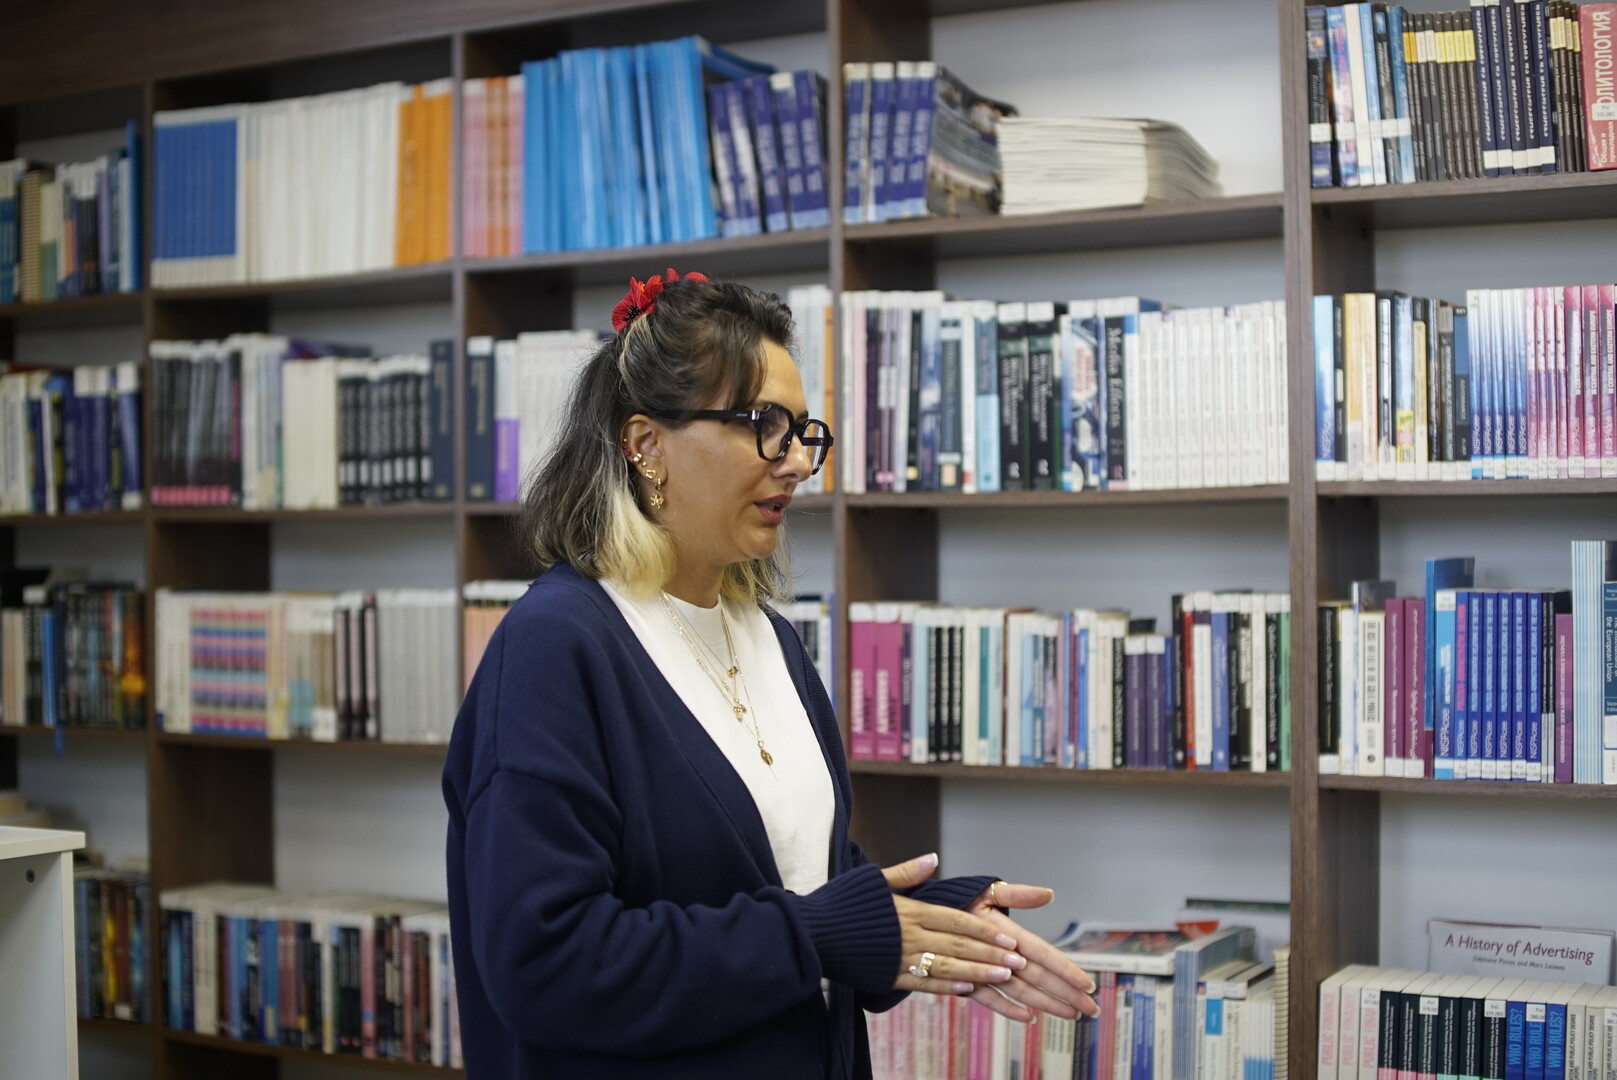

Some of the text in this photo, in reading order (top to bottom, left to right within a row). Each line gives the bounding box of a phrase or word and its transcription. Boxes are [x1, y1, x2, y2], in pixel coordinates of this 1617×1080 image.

[1592, 11, 1615, 104] ОЛИТОЛОГИЯ
[1605, 629, 1613, 661] European
[1440, 708, 1450, 756] NISPAcee
[1444, 933, 1595, 966] A History of Advertising
[1321, 992, 1334, 1065] PUBLIC FINANCE
[1343, 992, 1354, 1065] PUBLIC FINANCE
[1364, 1036, 1376, 1068] PUBLIC
[1508, 1008, 1522, 1065] WHO RULES?
[1528, 1022, 1542, 1044] RULE
[1548, 1011, 1562, 1068] WHO RULES?
[1528, 1047, 1542, 1068] WHO
